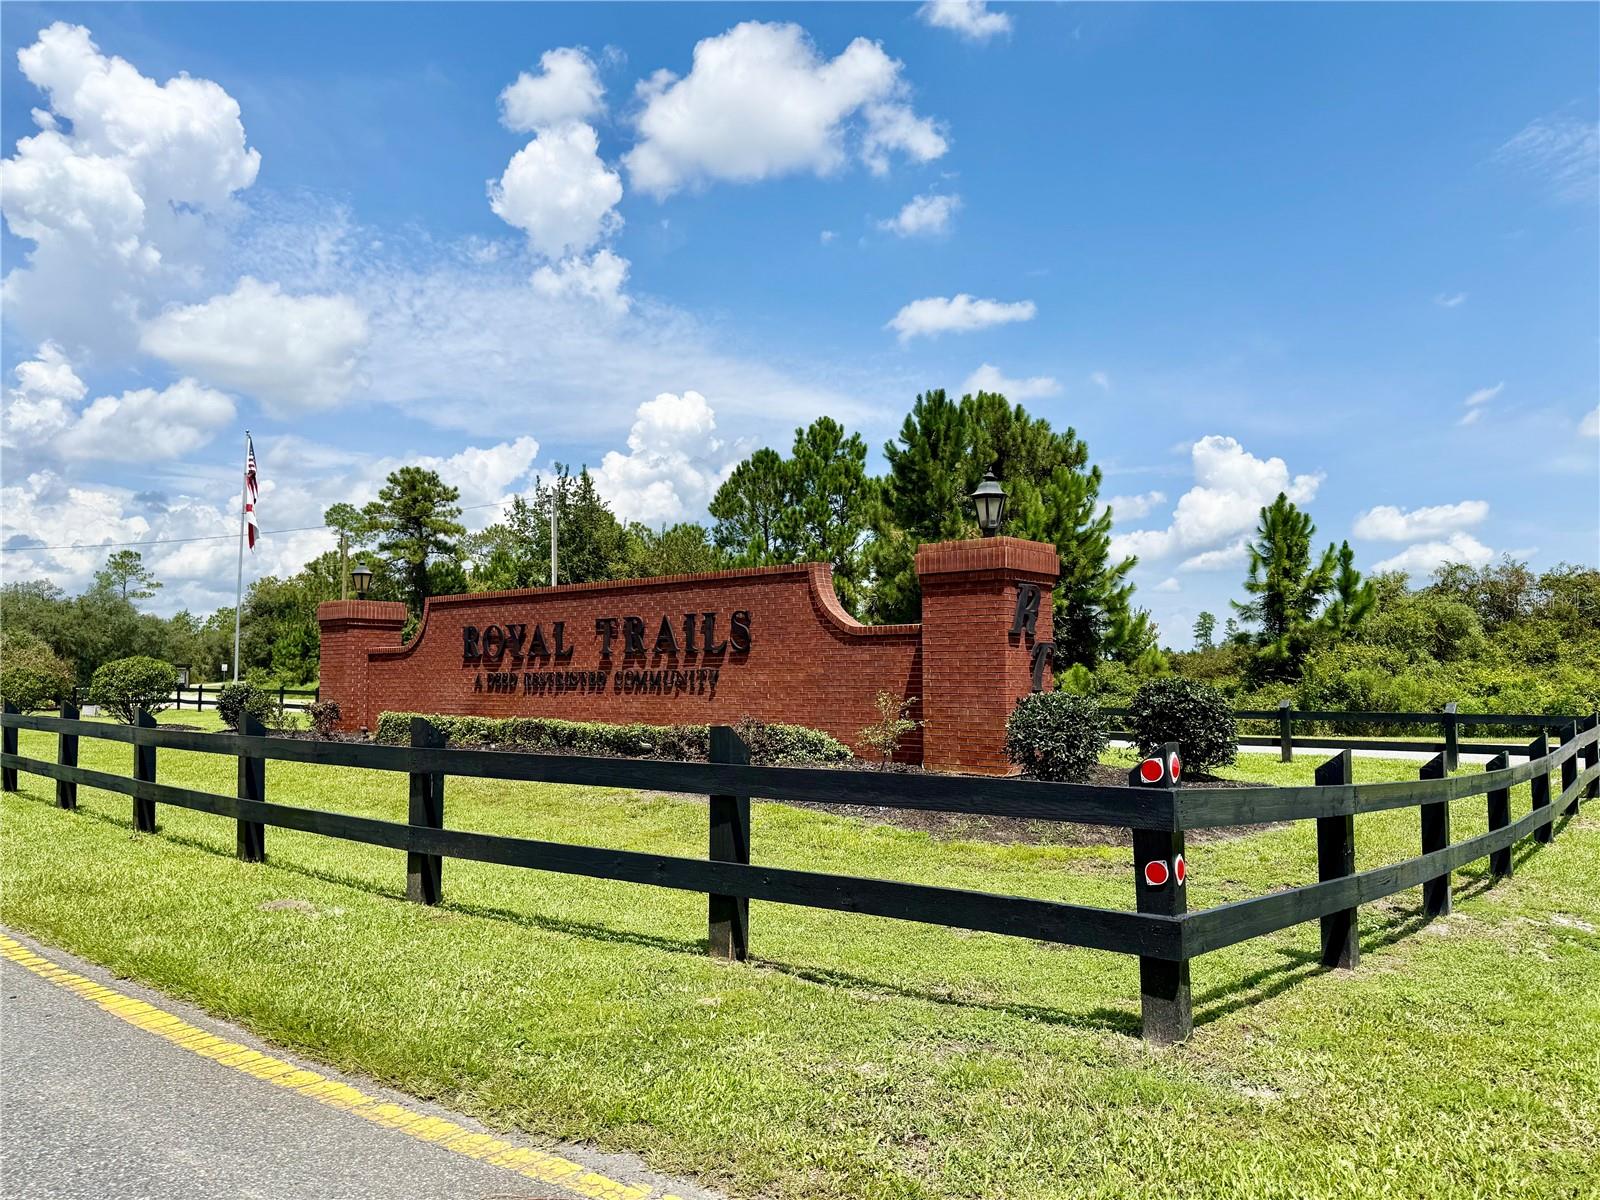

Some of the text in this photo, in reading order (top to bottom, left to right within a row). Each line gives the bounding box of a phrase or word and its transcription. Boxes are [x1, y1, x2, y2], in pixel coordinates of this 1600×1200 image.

[462, 610, 751, 661] ROYAL TRAILS
[474, 672, 483, 689] A
[614, 668, 720, 692] COMMUNITY
